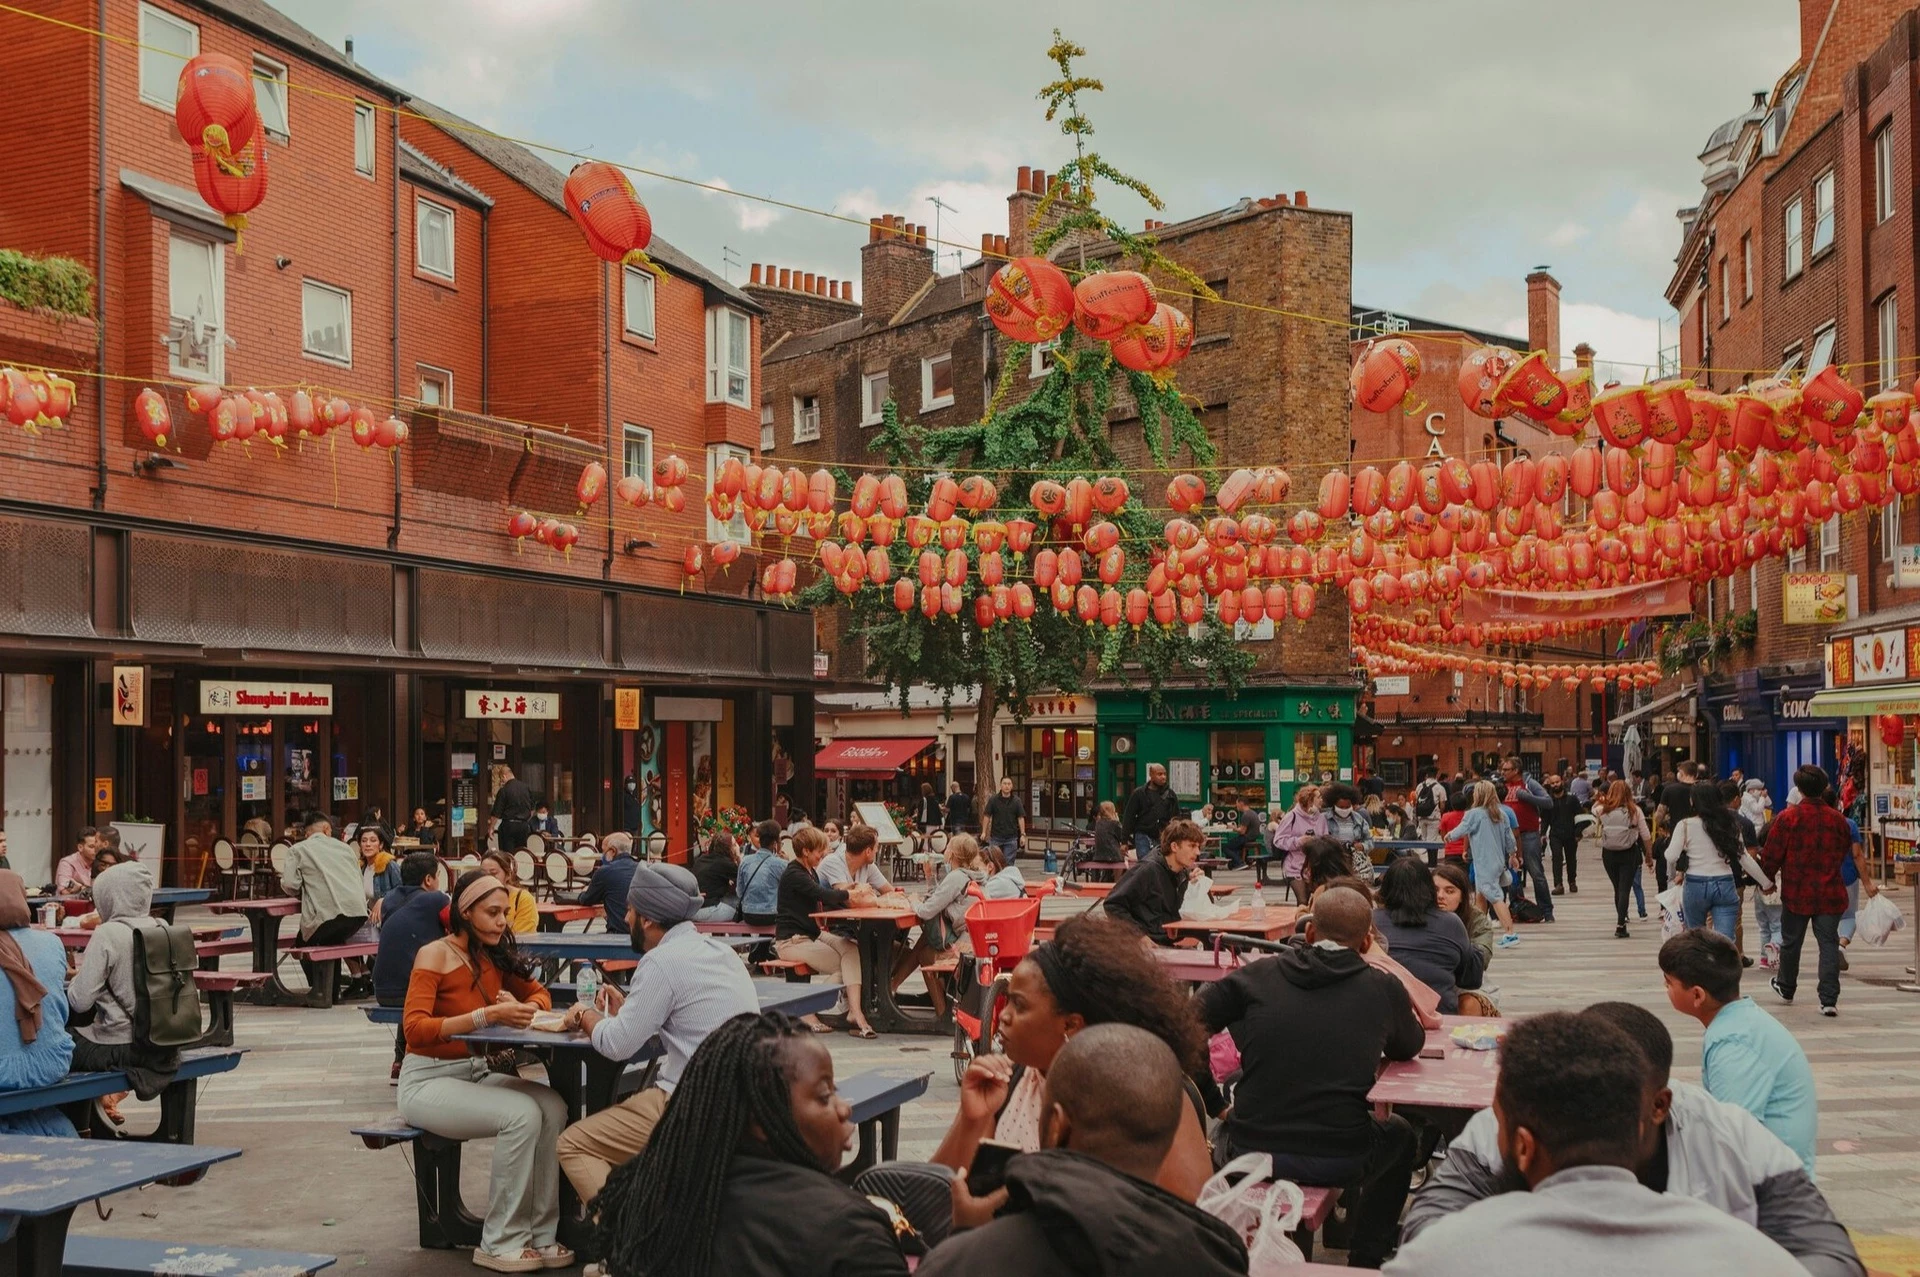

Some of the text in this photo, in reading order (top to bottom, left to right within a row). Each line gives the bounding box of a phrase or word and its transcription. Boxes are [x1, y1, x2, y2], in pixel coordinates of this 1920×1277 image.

[236, 690, 329, 708] Shanghai Modern
[1147, 703, 1176, 720] JEN
